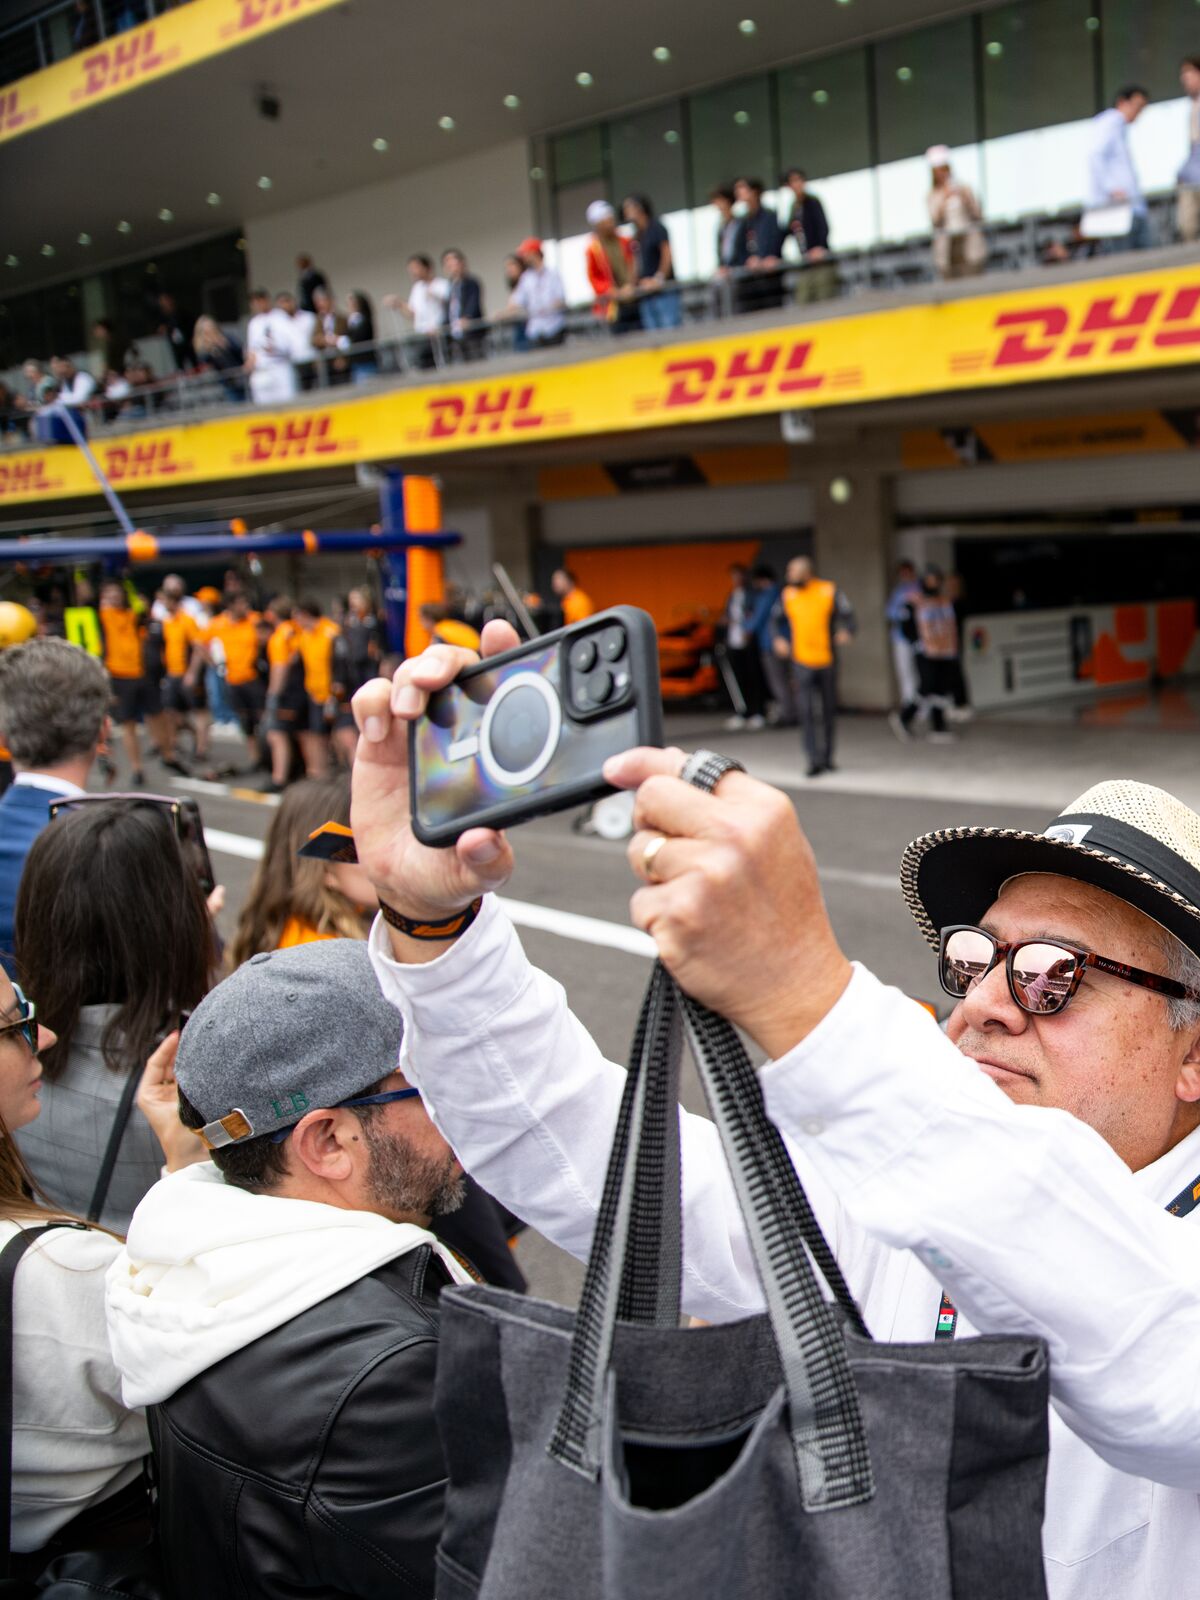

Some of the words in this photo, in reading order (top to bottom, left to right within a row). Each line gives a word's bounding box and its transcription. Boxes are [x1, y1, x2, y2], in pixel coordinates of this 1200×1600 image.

[83, 28, 163, 95] DHL
[663, 341, 827, 409] DHL
[426, 385, 546, 440] DHL
[104, 441, 178, 481] DHL
[247, 416, 340, 462] DHL
[271, 1089, 311, 1119] LB
